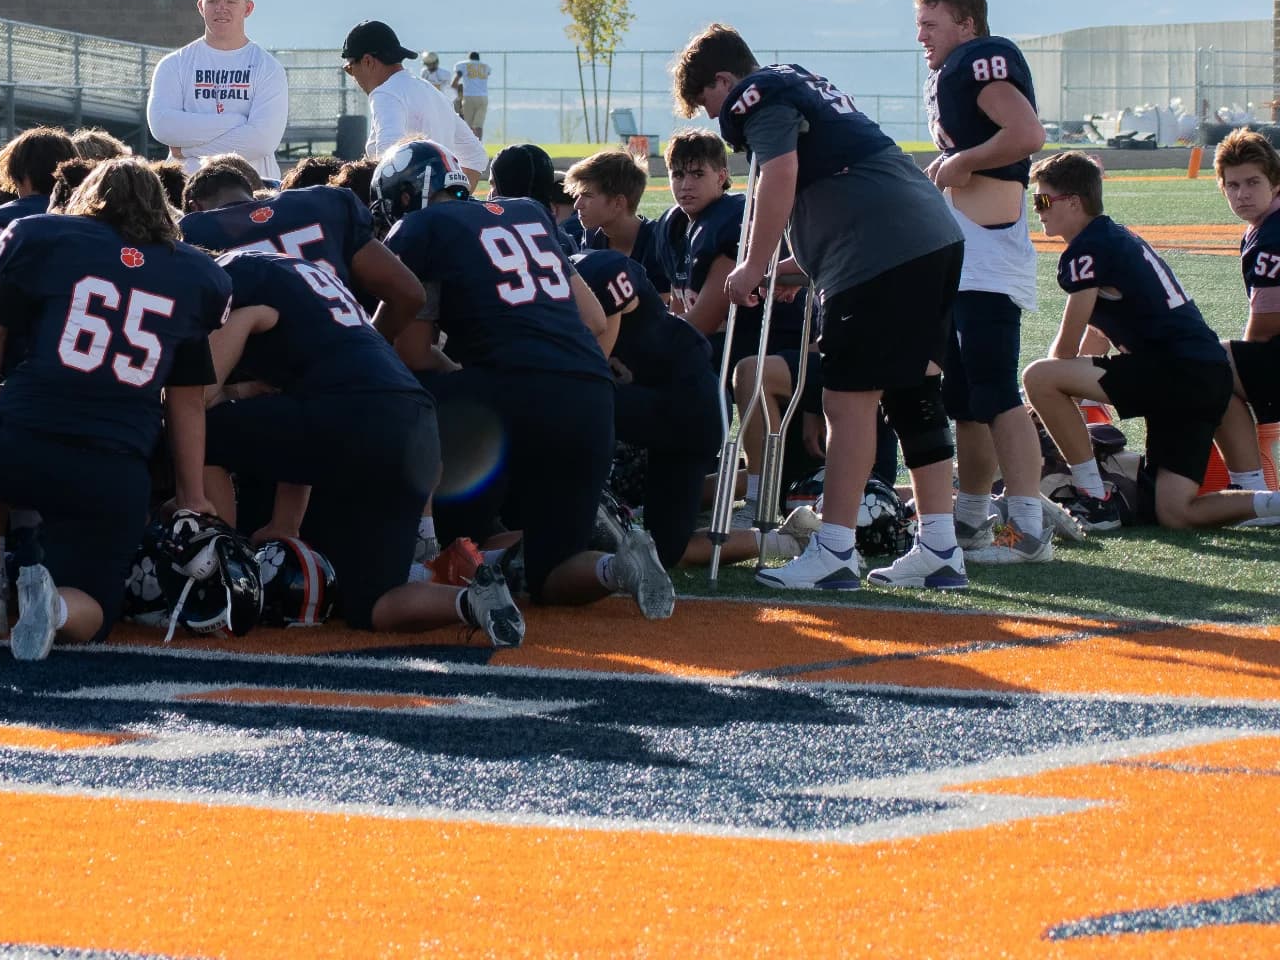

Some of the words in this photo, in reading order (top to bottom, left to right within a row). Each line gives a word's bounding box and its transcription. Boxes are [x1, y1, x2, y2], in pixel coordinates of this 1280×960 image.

[972, 55, 1008, 82] 88
[479, 221, 571, 307] 95
[1069, 255, 1095, 282] 12
[1254, 252, 1280, 279] 57
[606, 271, 635, 307] 16
[58, 275, 176, 387] 65
